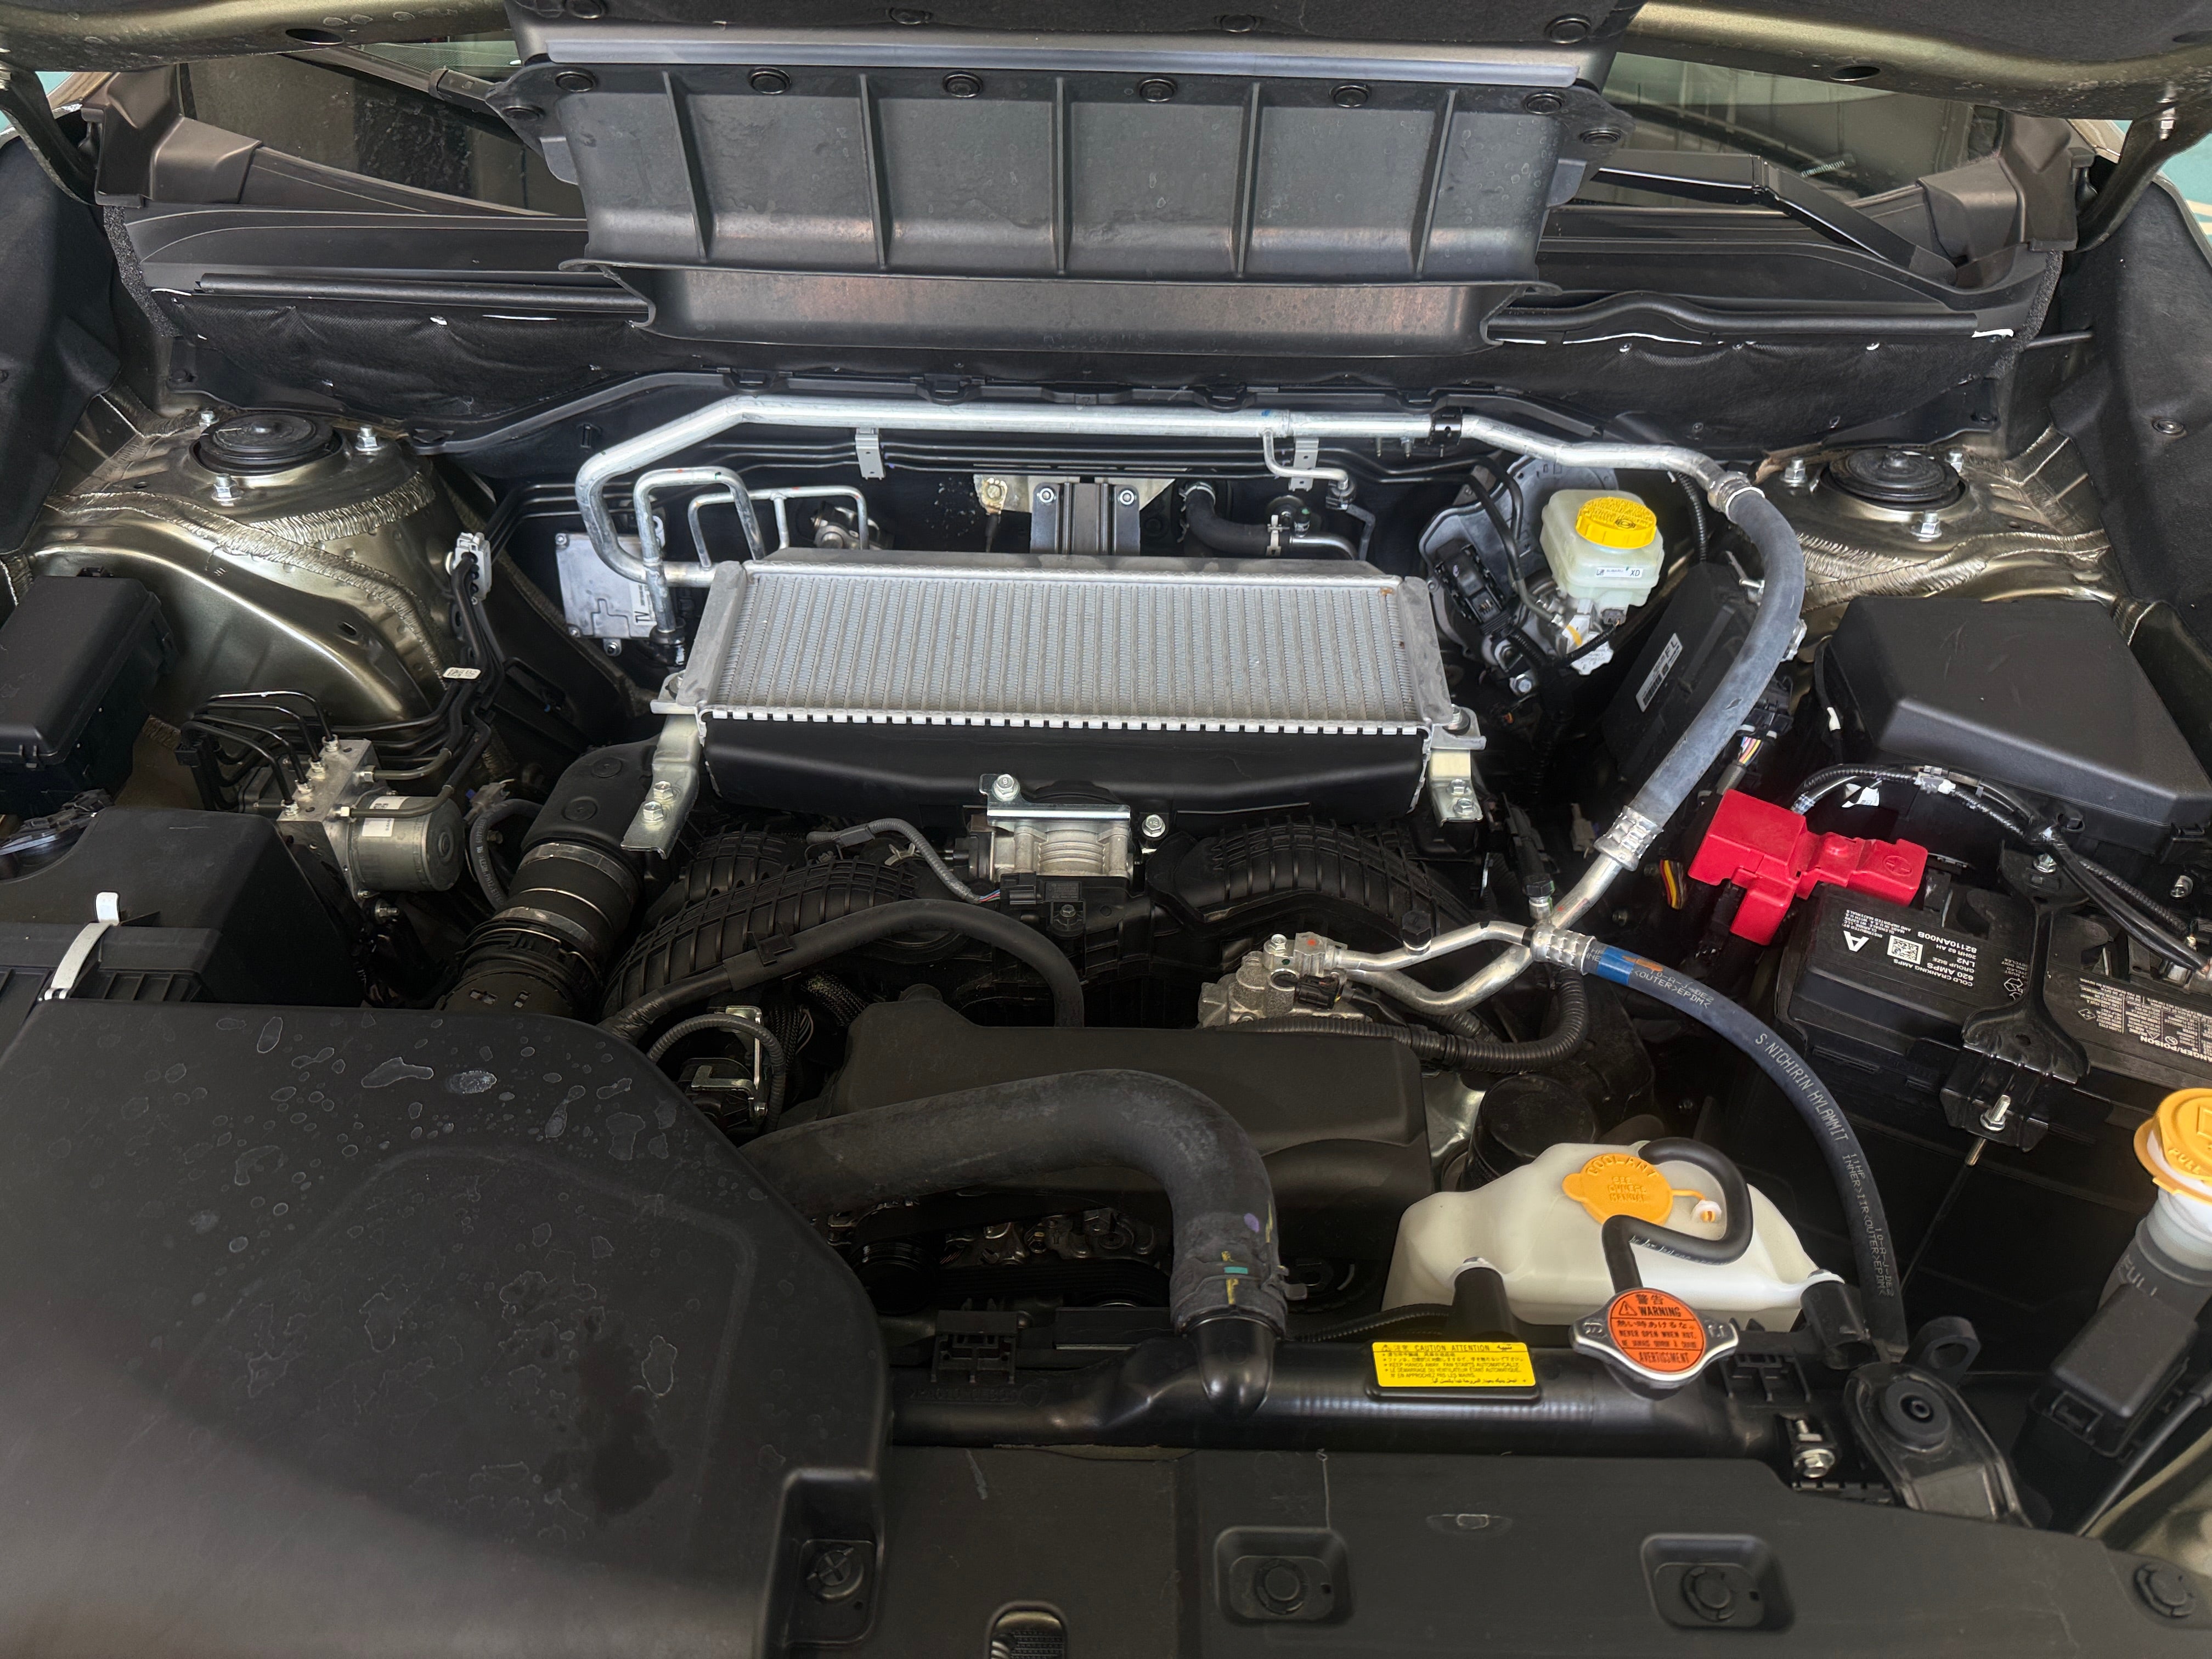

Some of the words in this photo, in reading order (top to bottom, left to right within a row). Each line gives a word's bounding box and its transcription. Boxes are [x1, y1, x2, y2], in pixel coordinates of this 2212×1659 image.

[1874, 918, 1900, 928] IMPORTED
[1843, 930, 1869, 952] A
[1917, 931, 1977, 953] 82110AN00B
[1932, 956, 1948, 965] SIZE
[1957, 950, 1976, 960] 20HR
[1893, 958, 1913, 968] AMPS
[1948, 962, 1974, 973] GROUP
[1956, 957, 1975, 967] LN2
[1914, 965, 1951, 980] CRANKING
[1926, 962, 1955, 975] AMPS
[1953, 977, 1973, 986] COLD
[1956, 971, 1973, 981] 620
[2140, 1035, 2212, 1062] ANGER/POISON
[1807, 1090, 1849, 1140] HYLAMMIT
[1585, 1155, 1660, 1178] COOLANT
[1850, 1153, 1865, 1178] 11HP
[2168, 1147, 2202, 1175] PULL
[1612, 1176, 1633, 1185] SEE
[1610, 1193, 1647, 1203] MANUAL
[1638, 1306, 1681, 1317] WARNING
